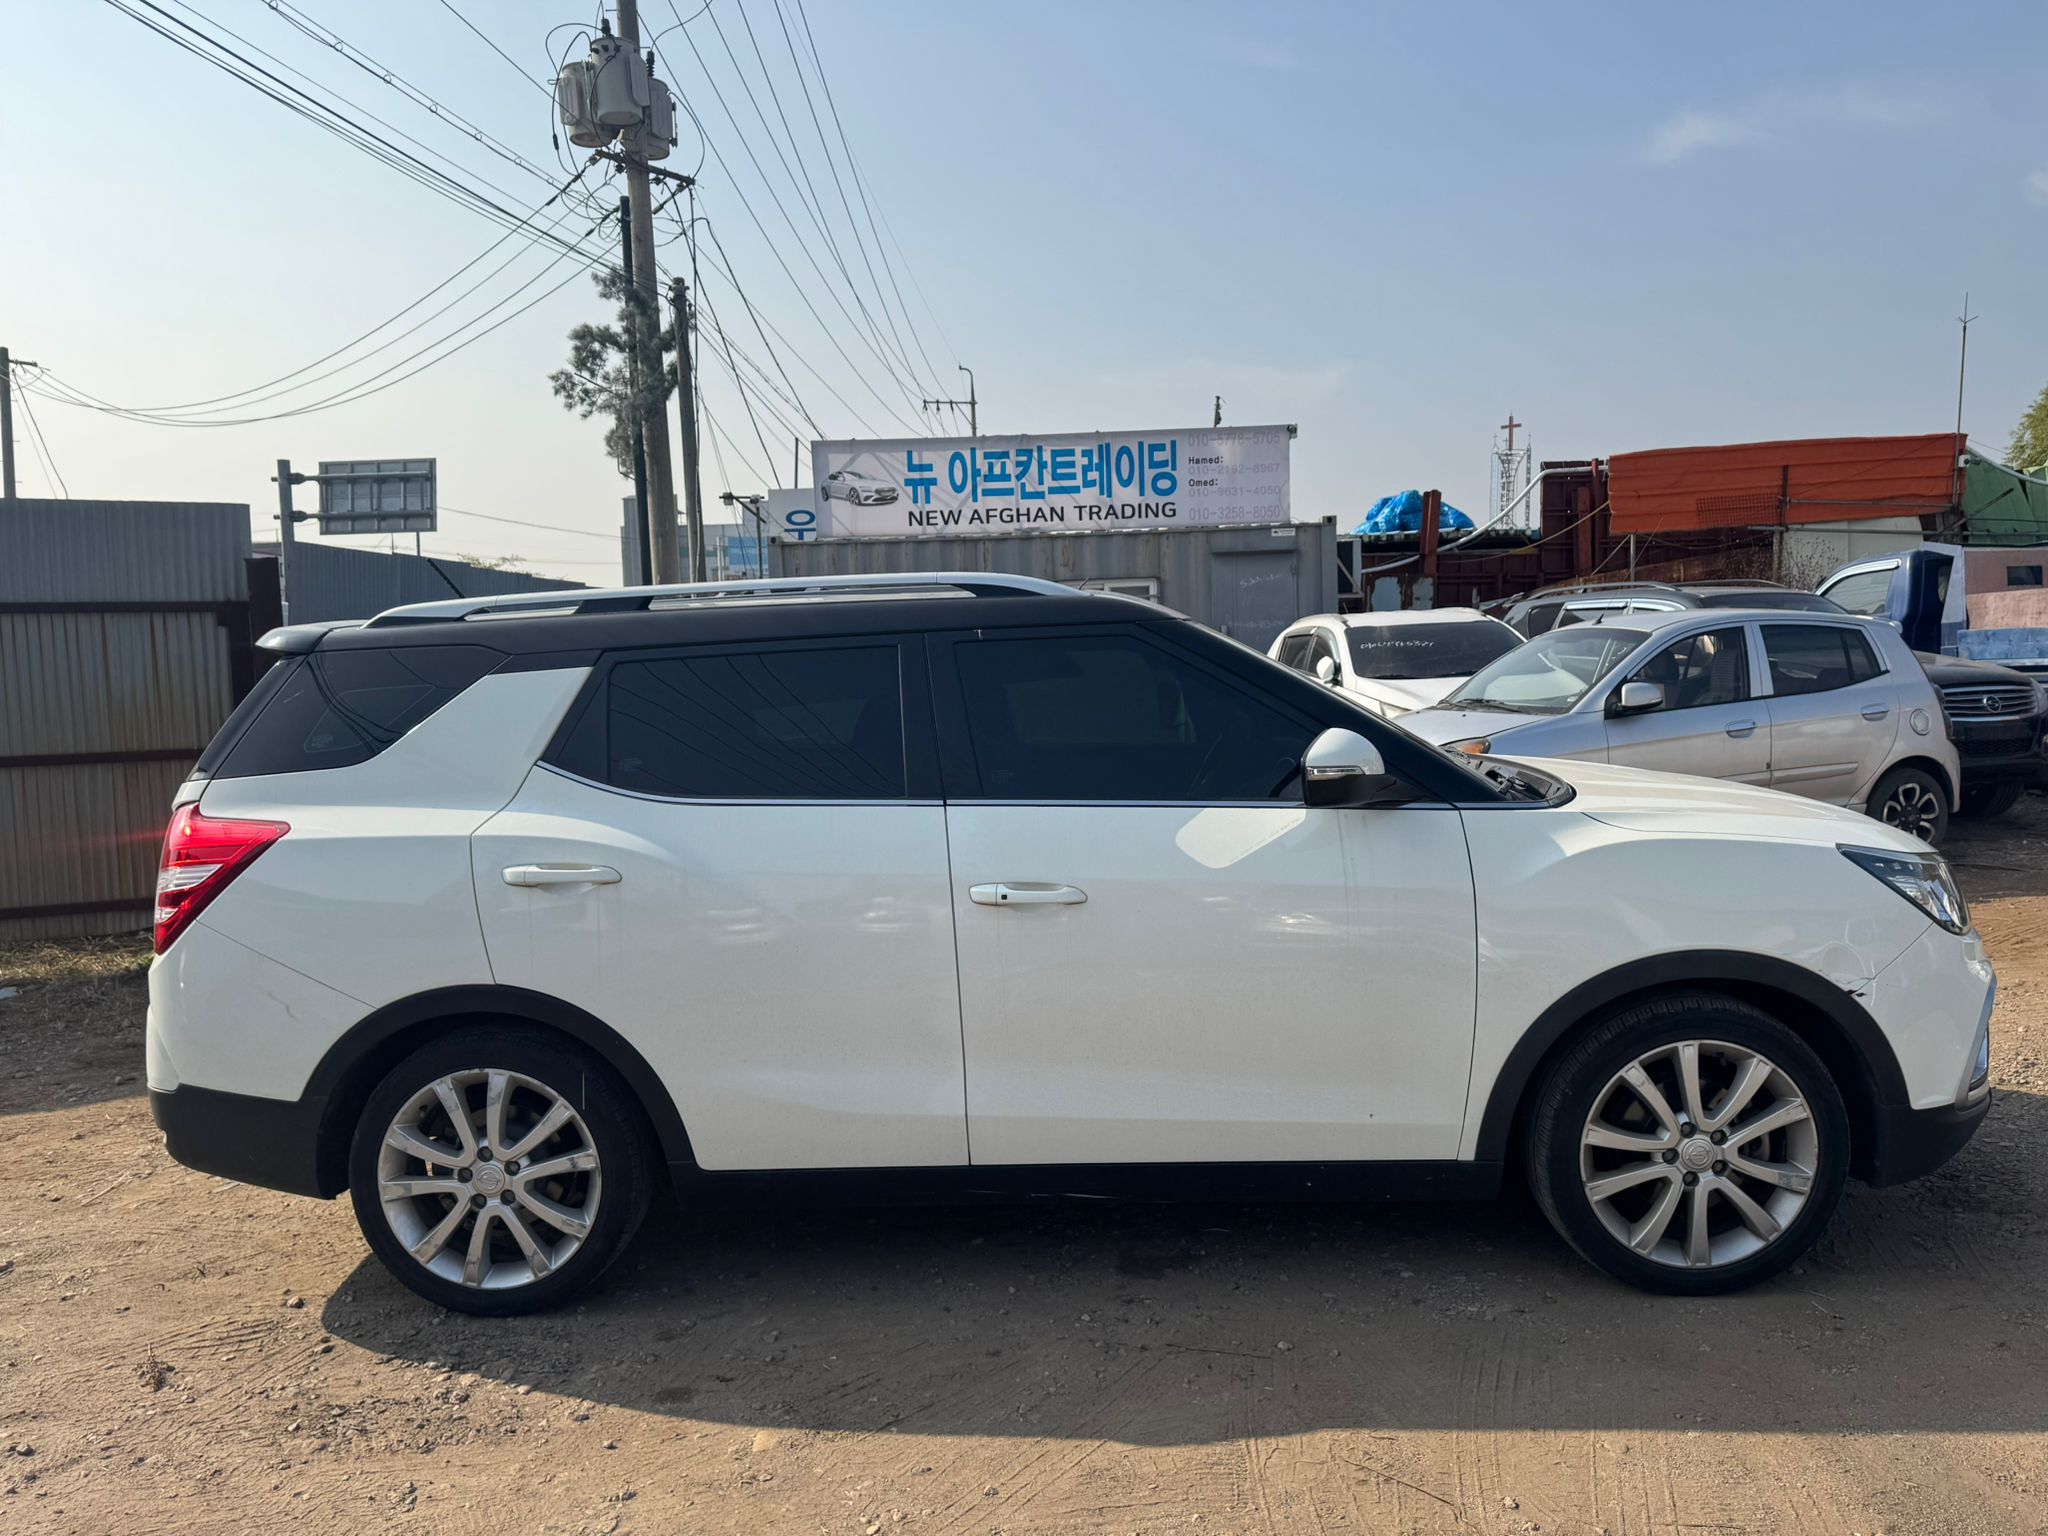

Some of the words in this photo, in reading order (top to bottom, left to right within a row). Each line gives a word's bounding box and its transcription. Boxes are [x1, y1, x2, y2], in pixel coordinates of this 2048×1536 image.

[1188, 456, 1224, 465] Hamed:
[904, 450, 937, 505] 뉴
[948, 439, 1178, 503] 아프칸트레이딩
[1188, 478, 1219, 487] Omed:
[908, 509, 962, 527] NEW
[968, 506, 1065, 525] AFGHAN
[1073, 501, 1177, 521] TRADING
